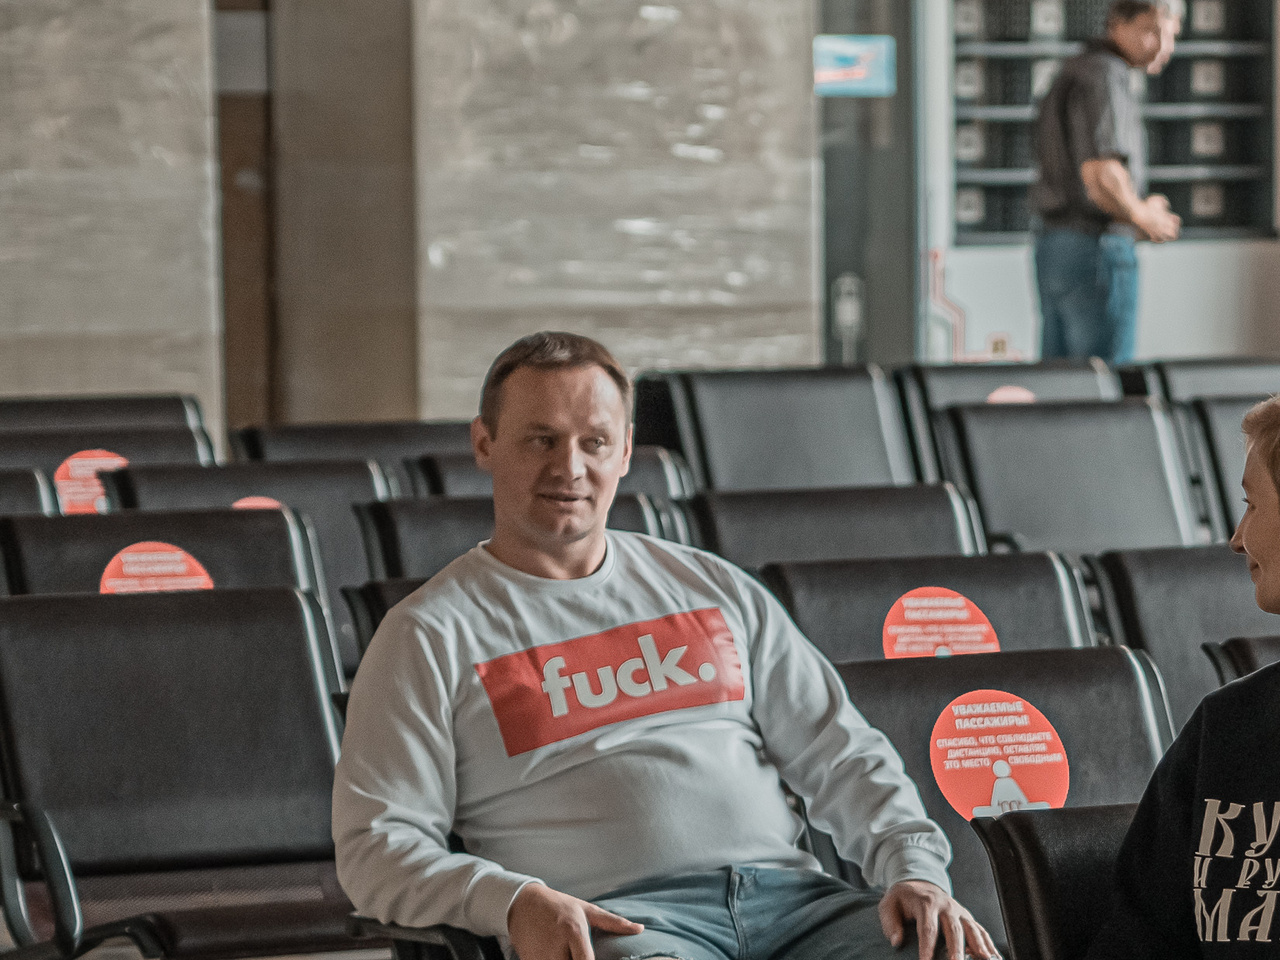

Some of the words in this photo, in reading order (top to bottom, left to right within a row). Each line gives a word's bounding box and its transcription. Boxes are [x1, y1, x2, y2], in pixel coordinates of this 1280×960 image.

[542, 634, 716, 717] fuck.
[952, 701, 1023, 716] УВАЖАЕМЫЕ
[978, 735, 996, 745] ЧТО
[961, 758, 991, 769] МЕСТО
[1193, 856, 1213, 888] И
